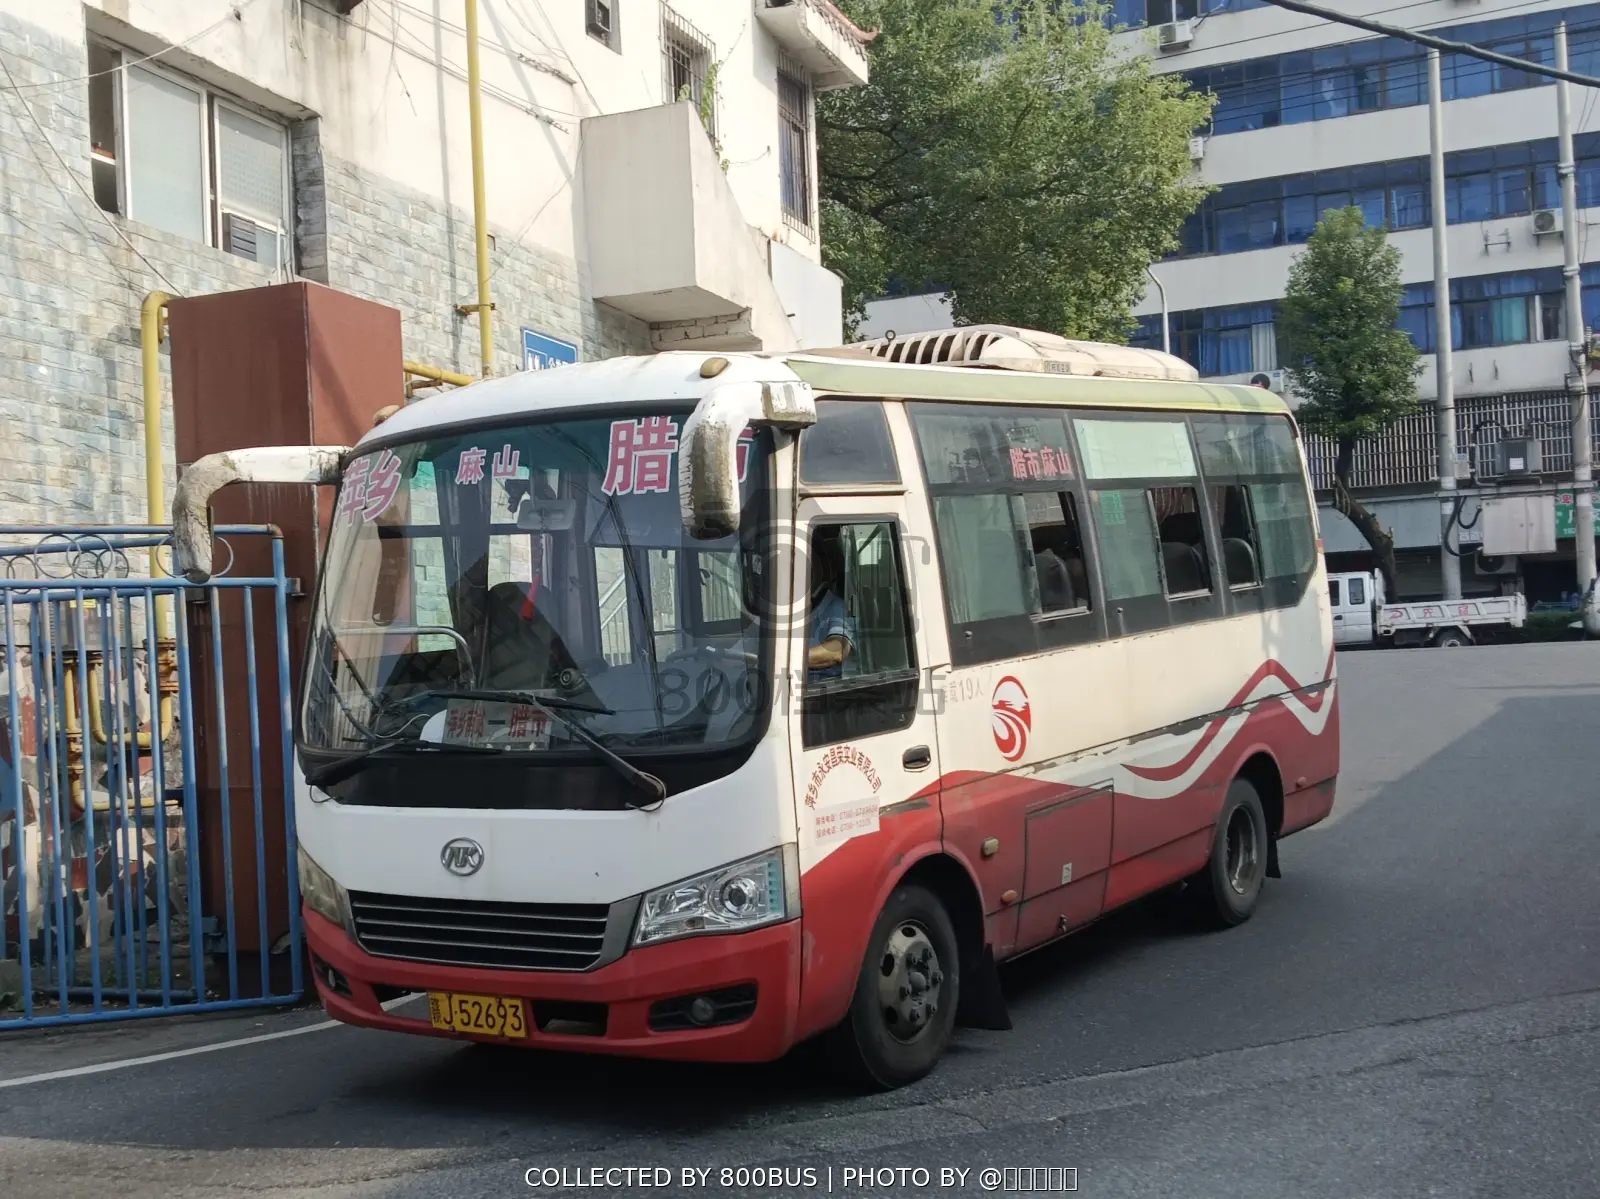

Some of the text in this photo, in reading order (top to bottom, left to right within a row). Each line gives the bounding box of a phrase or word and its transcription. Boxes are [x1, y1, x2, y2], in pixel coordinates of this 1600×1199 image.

[455, 443, 521, 485] 麻山
[1009, 446, 1073, 480] 腊市麻山
